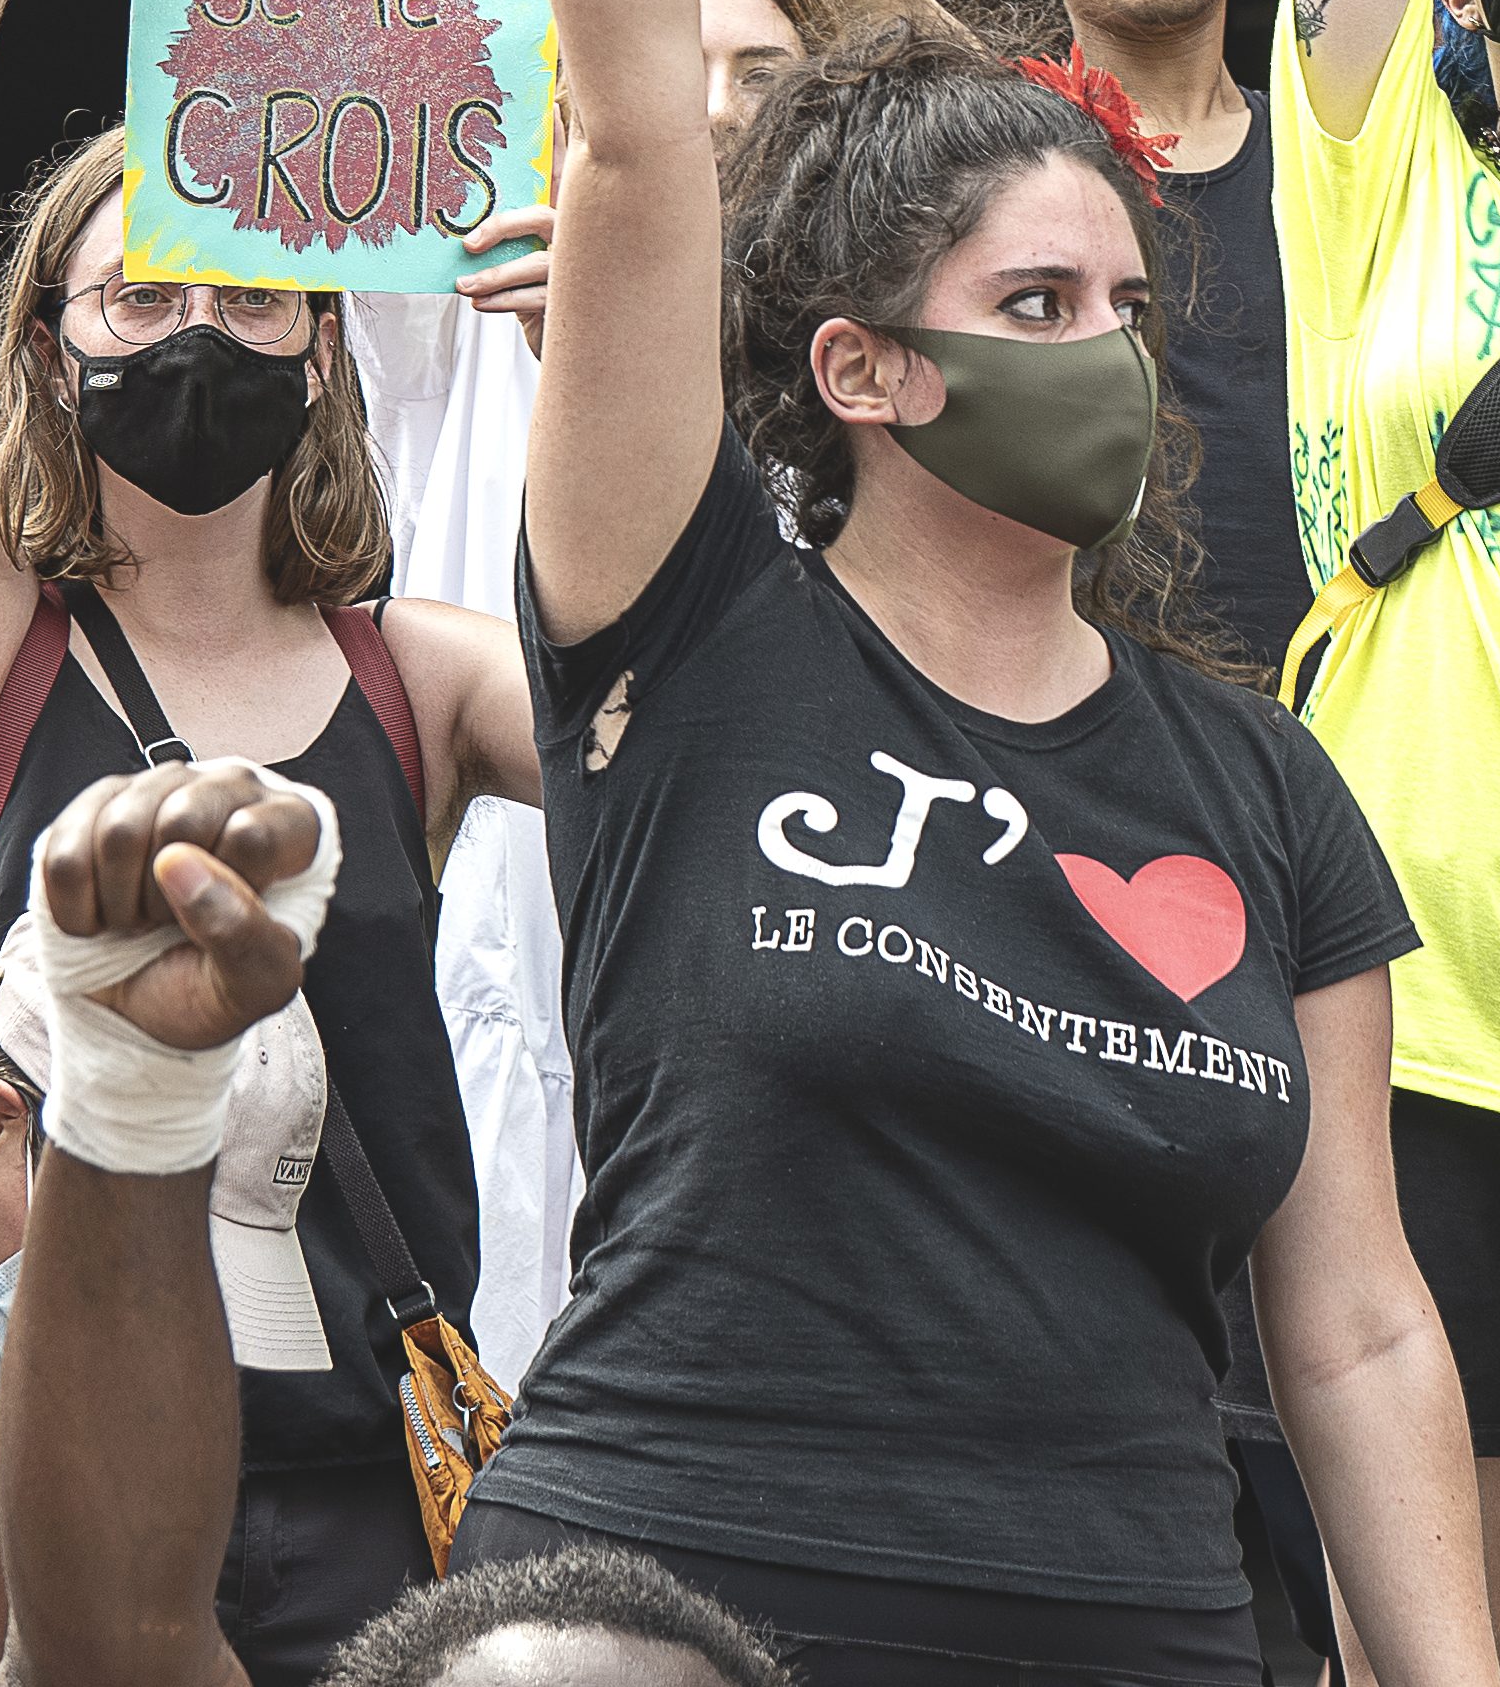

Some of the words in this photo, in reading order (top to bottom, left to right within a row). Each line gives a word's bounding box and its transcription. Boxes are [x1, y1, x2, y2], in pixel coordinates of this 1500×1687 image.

[163, 87, 505, 238] CROIS
[750, 905, 817, 953] LE
[835, 916, 1293, 1104] CONSENTEMENT
